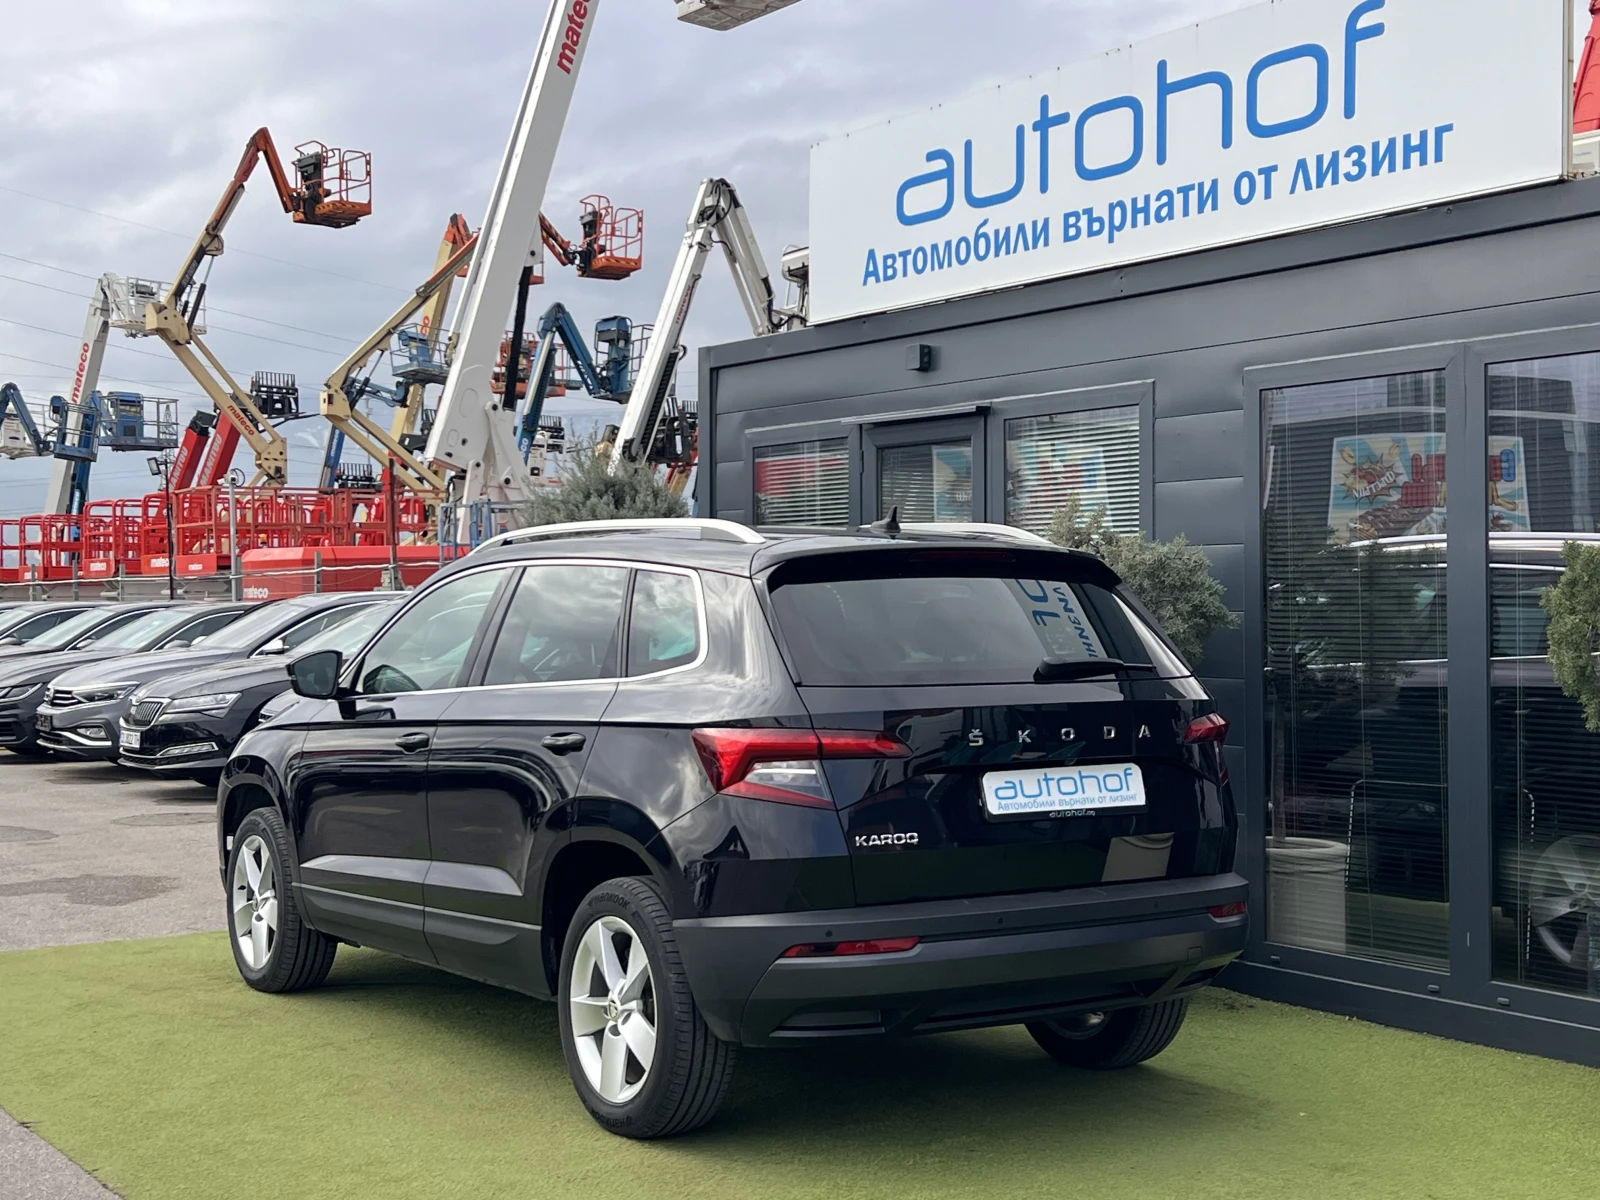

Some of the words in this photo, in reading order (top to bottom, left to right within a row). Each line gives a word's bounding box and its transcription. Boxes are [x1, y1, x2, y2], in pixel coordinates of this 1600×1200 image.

[557, 0, 591, 75] mate
[896, 0, 1386, 227] autohof
[862, 218, 1050, 286] Автомобили
[1063, 178, 1219, 243] върнати
[1233, 164, 1279, 206] от
[1289, 122, 1454, 195] лизинг
[71, 342, 90, 404] mateco
[226, 404, 255, 436] mateco
[199, 433, 222, 487] MANITOU
[968, 724, 1151, 747] ŠKODA
[994, 767, 1134, 801] autohof
[997, 798, 1056, 811] Автомобили
[1058, 795, 1097, 807] върнати
[1097, 795, 1107, 804] от
[1109, 793, 1138, 803] лизинг
[855, 832, 919, 847] KAROQ
